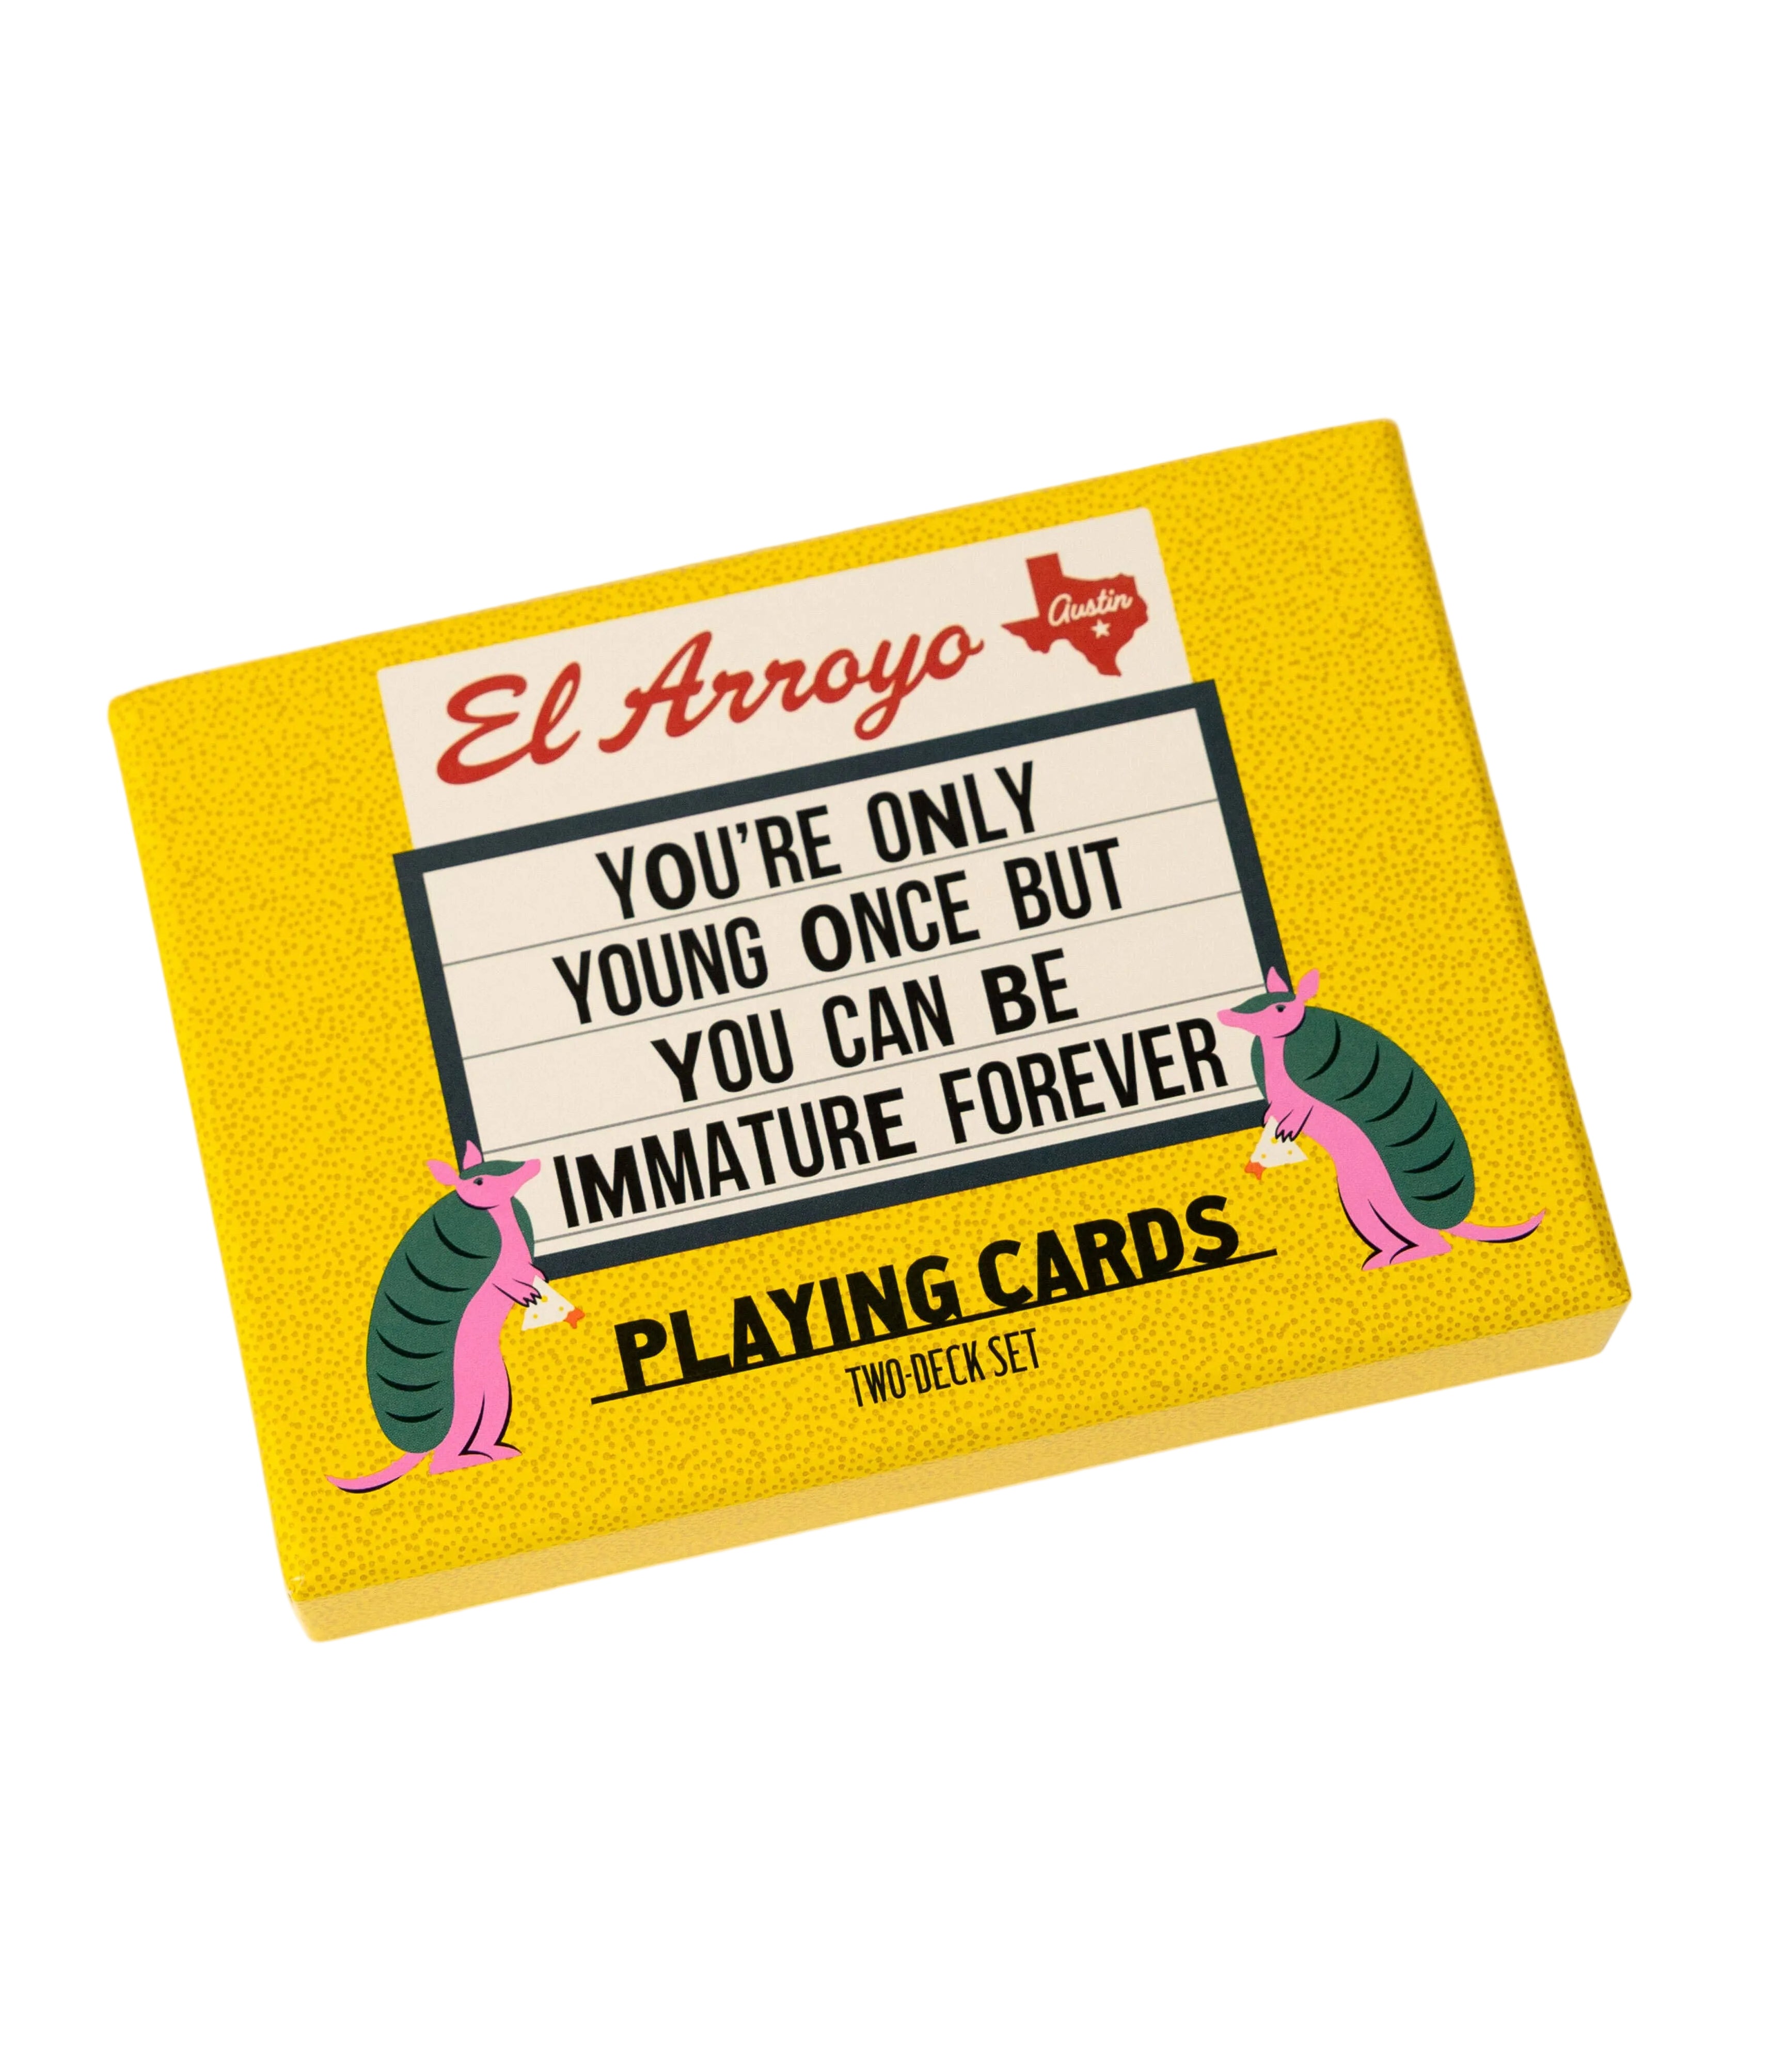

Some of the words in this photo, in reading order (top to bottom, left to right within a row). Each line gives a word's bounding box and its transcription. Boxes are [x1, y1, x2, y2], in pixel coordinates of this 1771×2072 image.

[1048, 589, 1133, 627] Austin
[436, 662, 581, 785] El
[598, 624, 985, 754] Arroyo
[595, 805, 843, 920] YOU'RE
[867, 760, 1037, 863] ONLY
[552, 916, 768, 1025] YOUNG
[801, 870, 981, 972] ONCE
[1003, 836, 1125, 930] BUT
[651, 1008, 794, 1103] YOU
[822, 974, 955, 1068] CAN
[981, 948, 1079, 1036] BE
[552, 1087, 918, 1228] IMMATURE
[939, 1018, 1228, 1145] FOREVER
[613, 1256, 962, 1393] PLAYING
[977, 1195, 1239, 1308] CARDS
[844, 1340, 986, 1407] TWO-DECK
[987, 1327, 1040, 1378] SET
